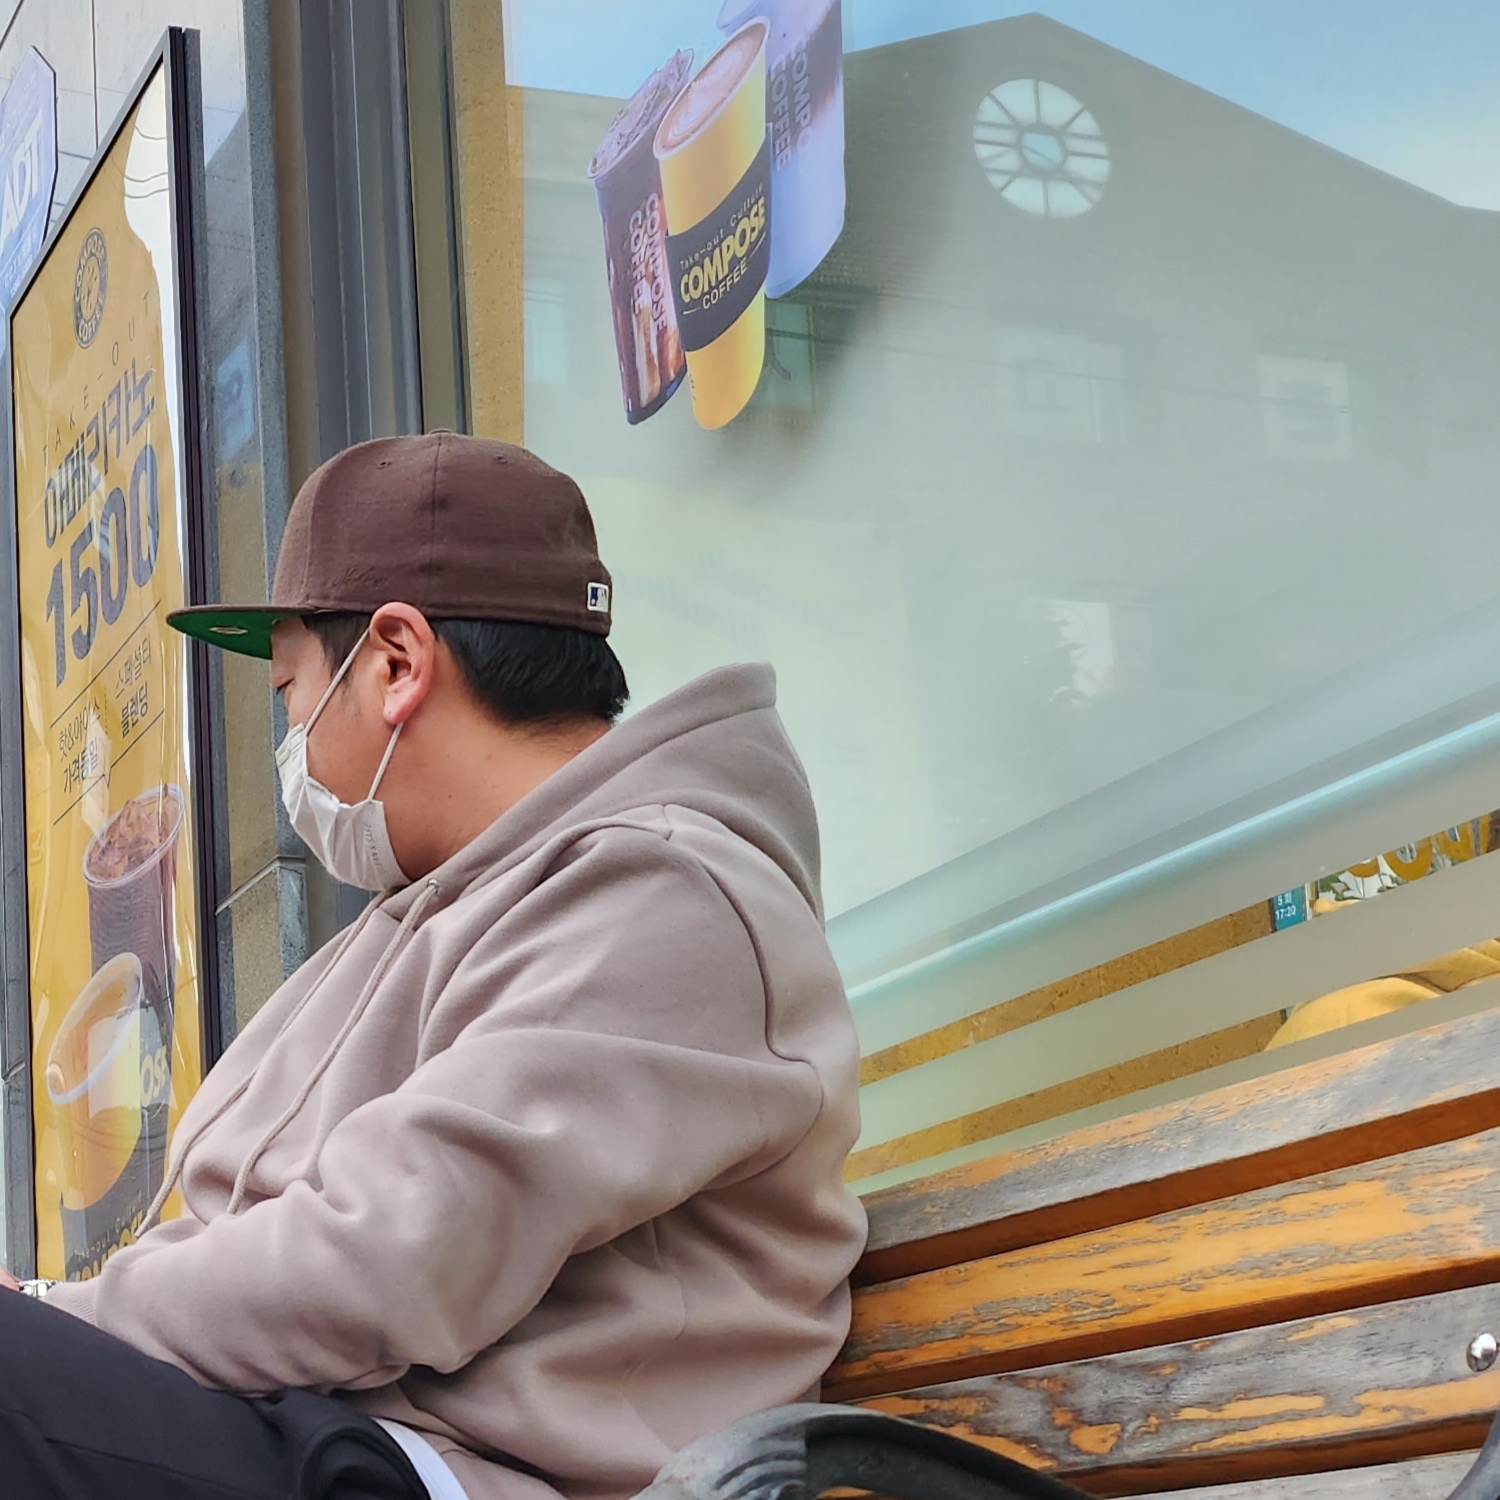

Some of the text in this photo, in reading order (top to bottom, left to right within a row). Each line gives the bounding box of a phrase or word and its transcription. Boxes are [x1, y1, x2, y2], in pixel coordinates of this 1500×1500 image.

[630, 210, 643, 314] COFFEE
[646, 192, 667, 333] COMPOSE
[681, 196, 765, 303] COMPOSE
[703, 257, 747, 309] COFFEE
[45, 444, 160, 688] 1500
[116, 634, 151, 699] 스페셜티
[121, 682, 149, 738] 블렌딩
[64, 737, 98, 793] 가격동일
